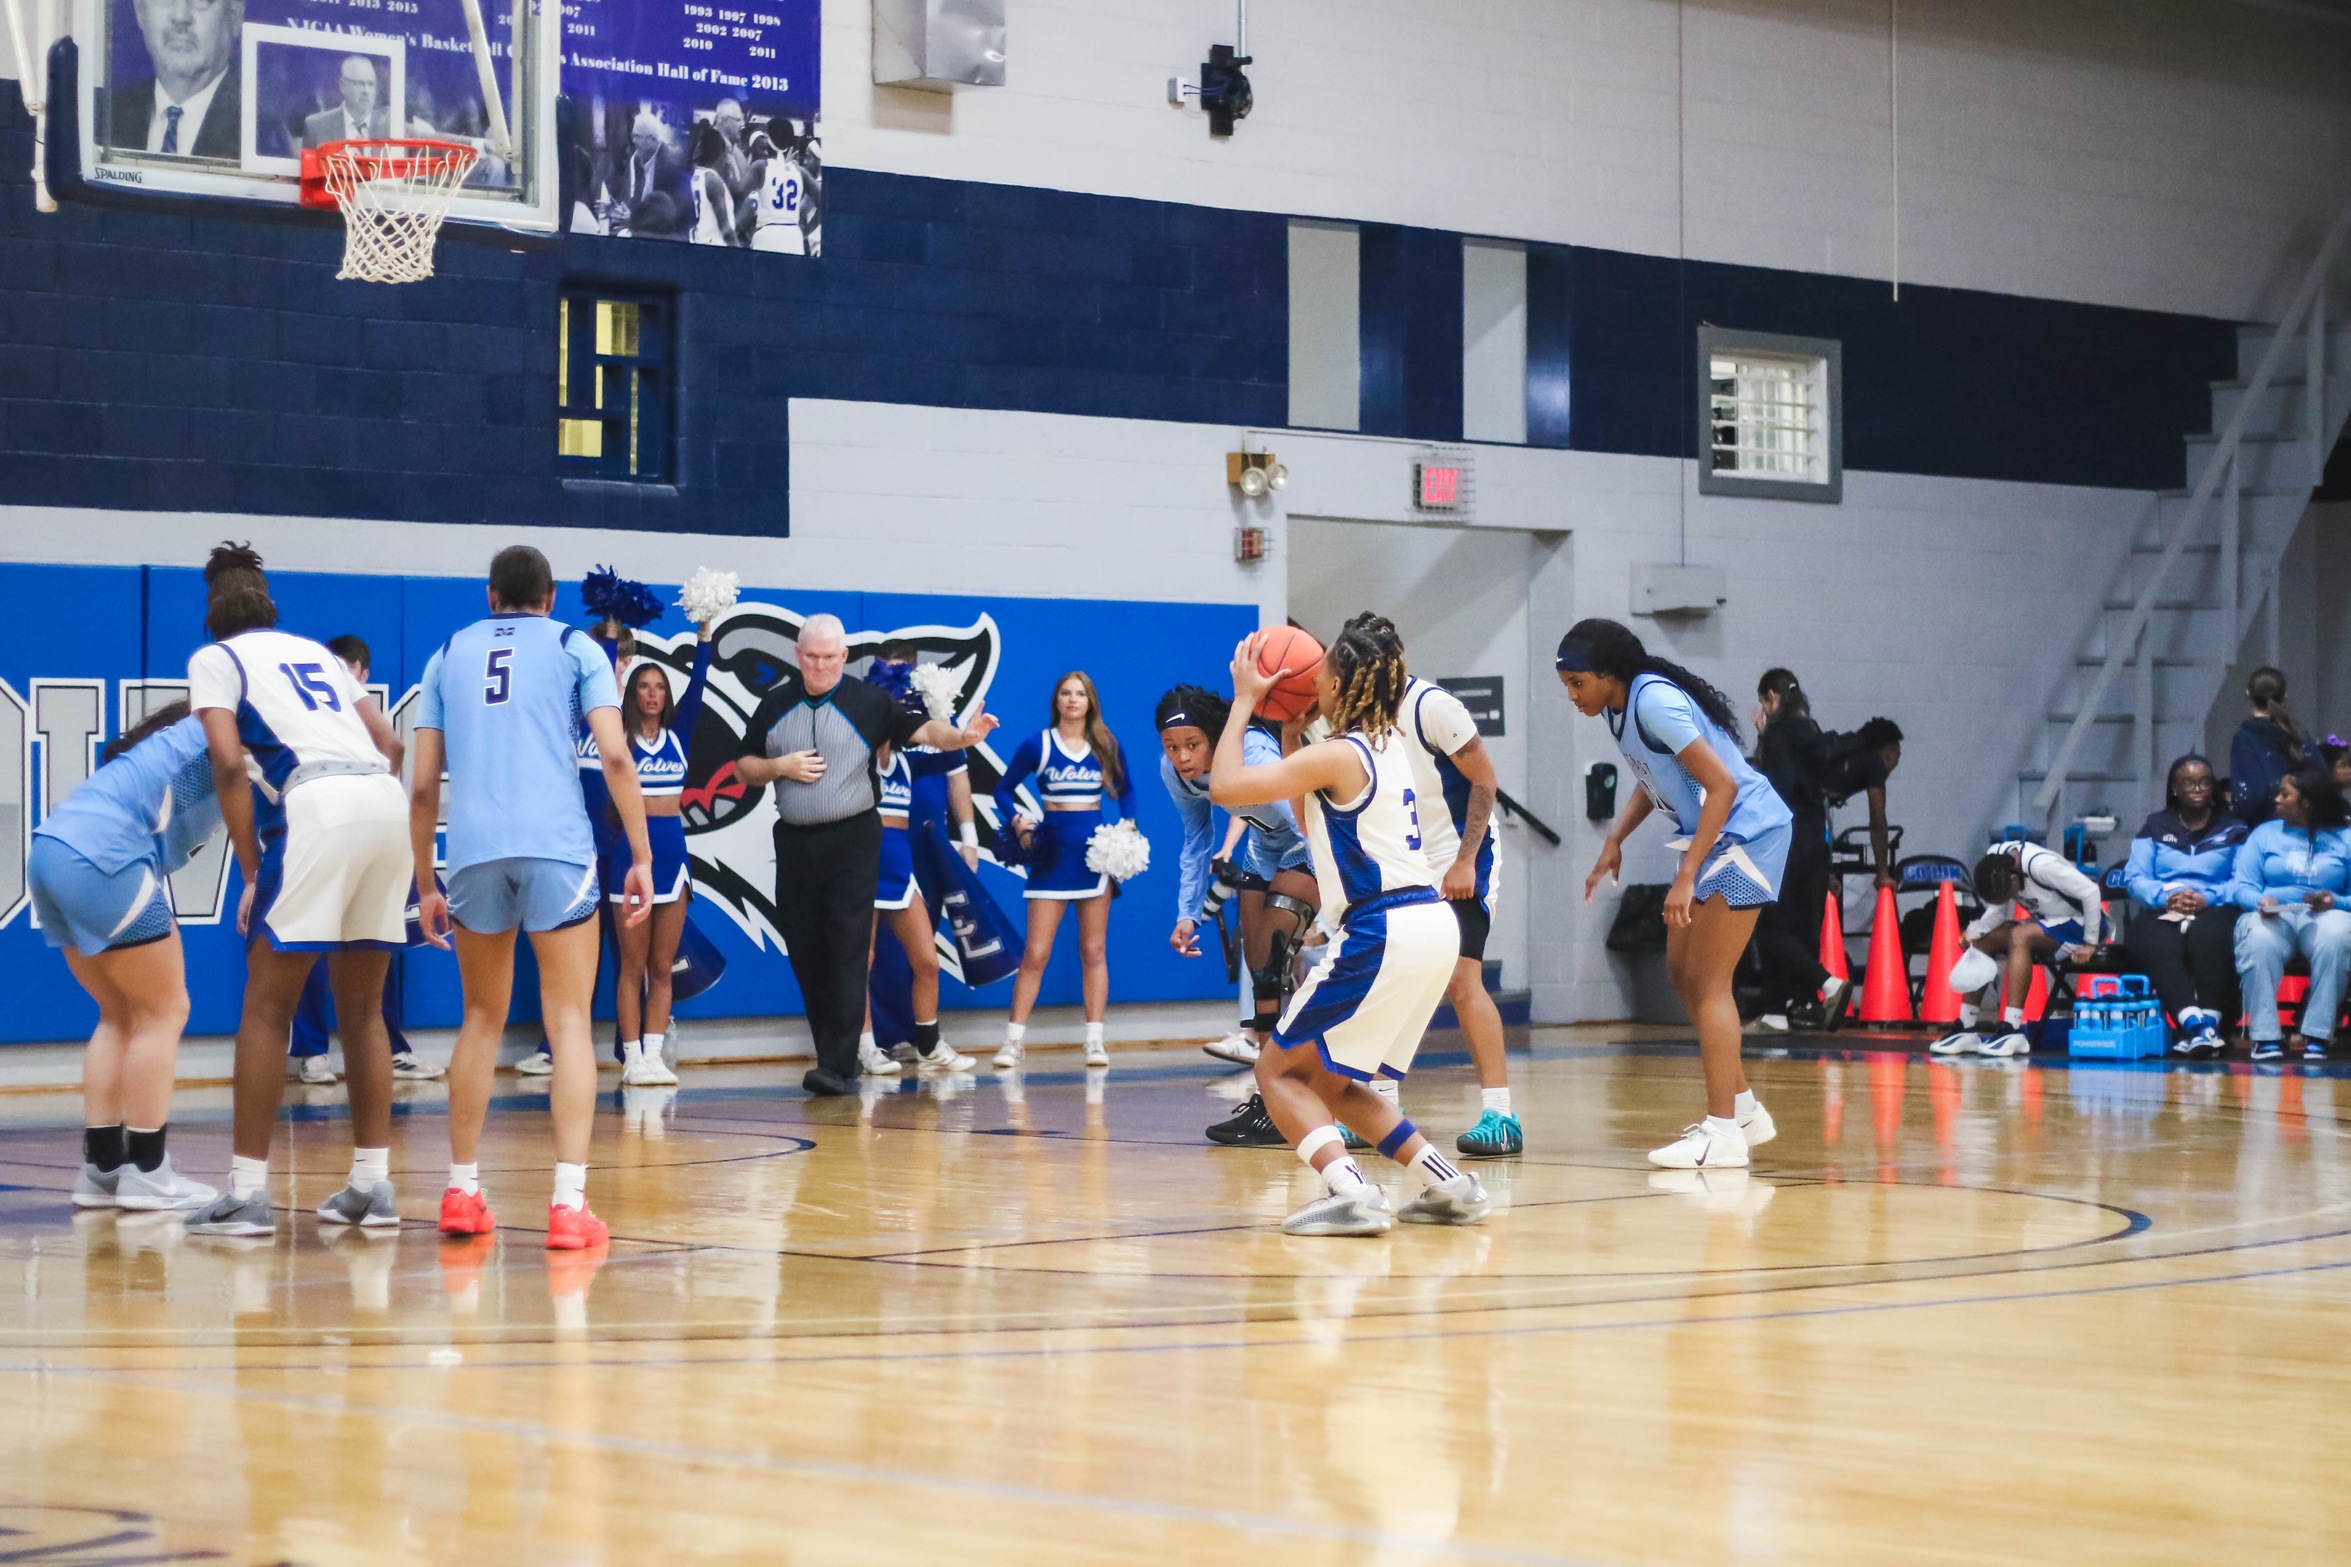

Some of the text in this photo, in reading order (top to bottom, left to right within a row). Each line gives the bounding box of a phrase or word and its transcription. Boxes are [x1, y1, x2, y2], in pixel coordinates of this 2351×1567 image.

[684, 4, 713, 18] 1993
[719, 9, 747, 24] 1997
[567, 23, 595, 36] 2011
[696, 22, 763, 42] 2002 2007
[683, 37, 776, 59] 2010 2011
[570, 52, 654, 76] Association
[657, 62, 689, 80] Hall
[692, 68, 709, 82] of
[710, 69, 749, 87] Fame
[752, 74, 789, 92] 2013
[94, 167, 142, 184] SPALDING
[771, 177, 798, 211] 32
[1424, 467, 1459, 504] EXIT
[277, 662, 342, 713] 15
[484, 646, 517, 706] 5
[1044, 764, 1102, 782] Wolve
[1402, 788, 1422, 851] 3
